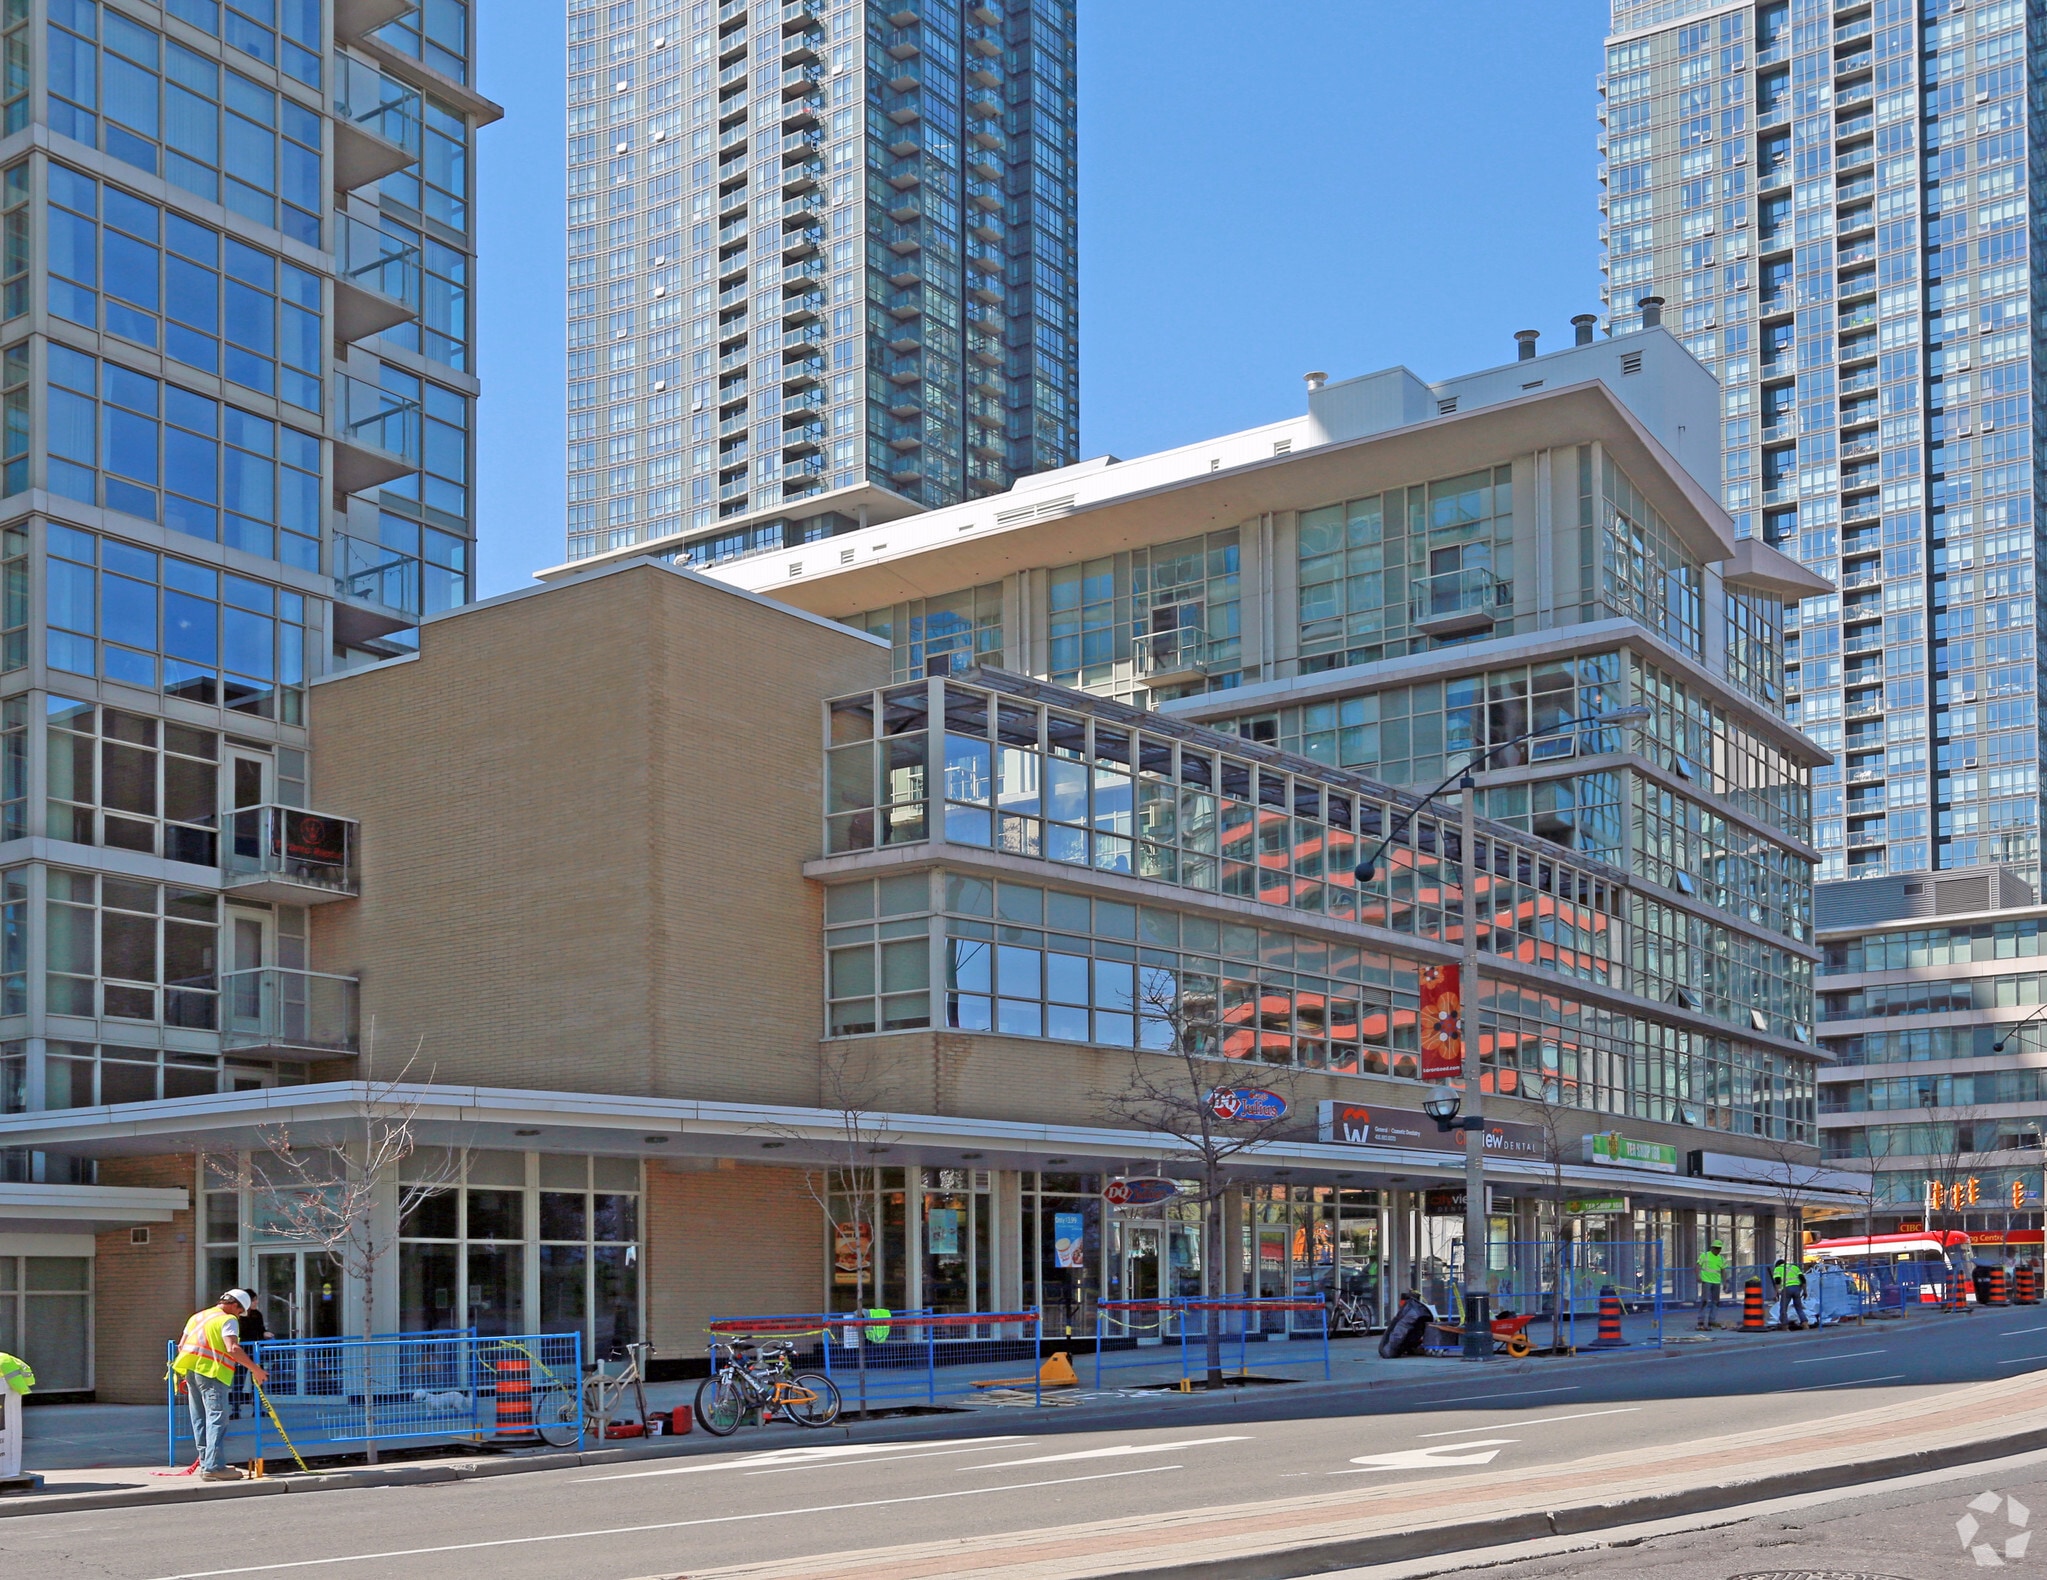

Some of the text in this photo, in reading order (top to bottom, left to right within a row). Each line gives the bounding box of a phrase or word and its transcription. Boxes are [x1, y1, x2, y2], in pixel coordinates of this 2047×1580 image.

[1241, 1099, 1279, 1117] Julius
[1503, 1140, 1536, 1153] DENTAL
[1626, 1142, 1637, 1157] TEA
[1108, 1186, 1129, 1199] DQ
[1431, 1194, 1468, 1206] cityvie
[1899, 1223, 1922, 1232] CIBC
